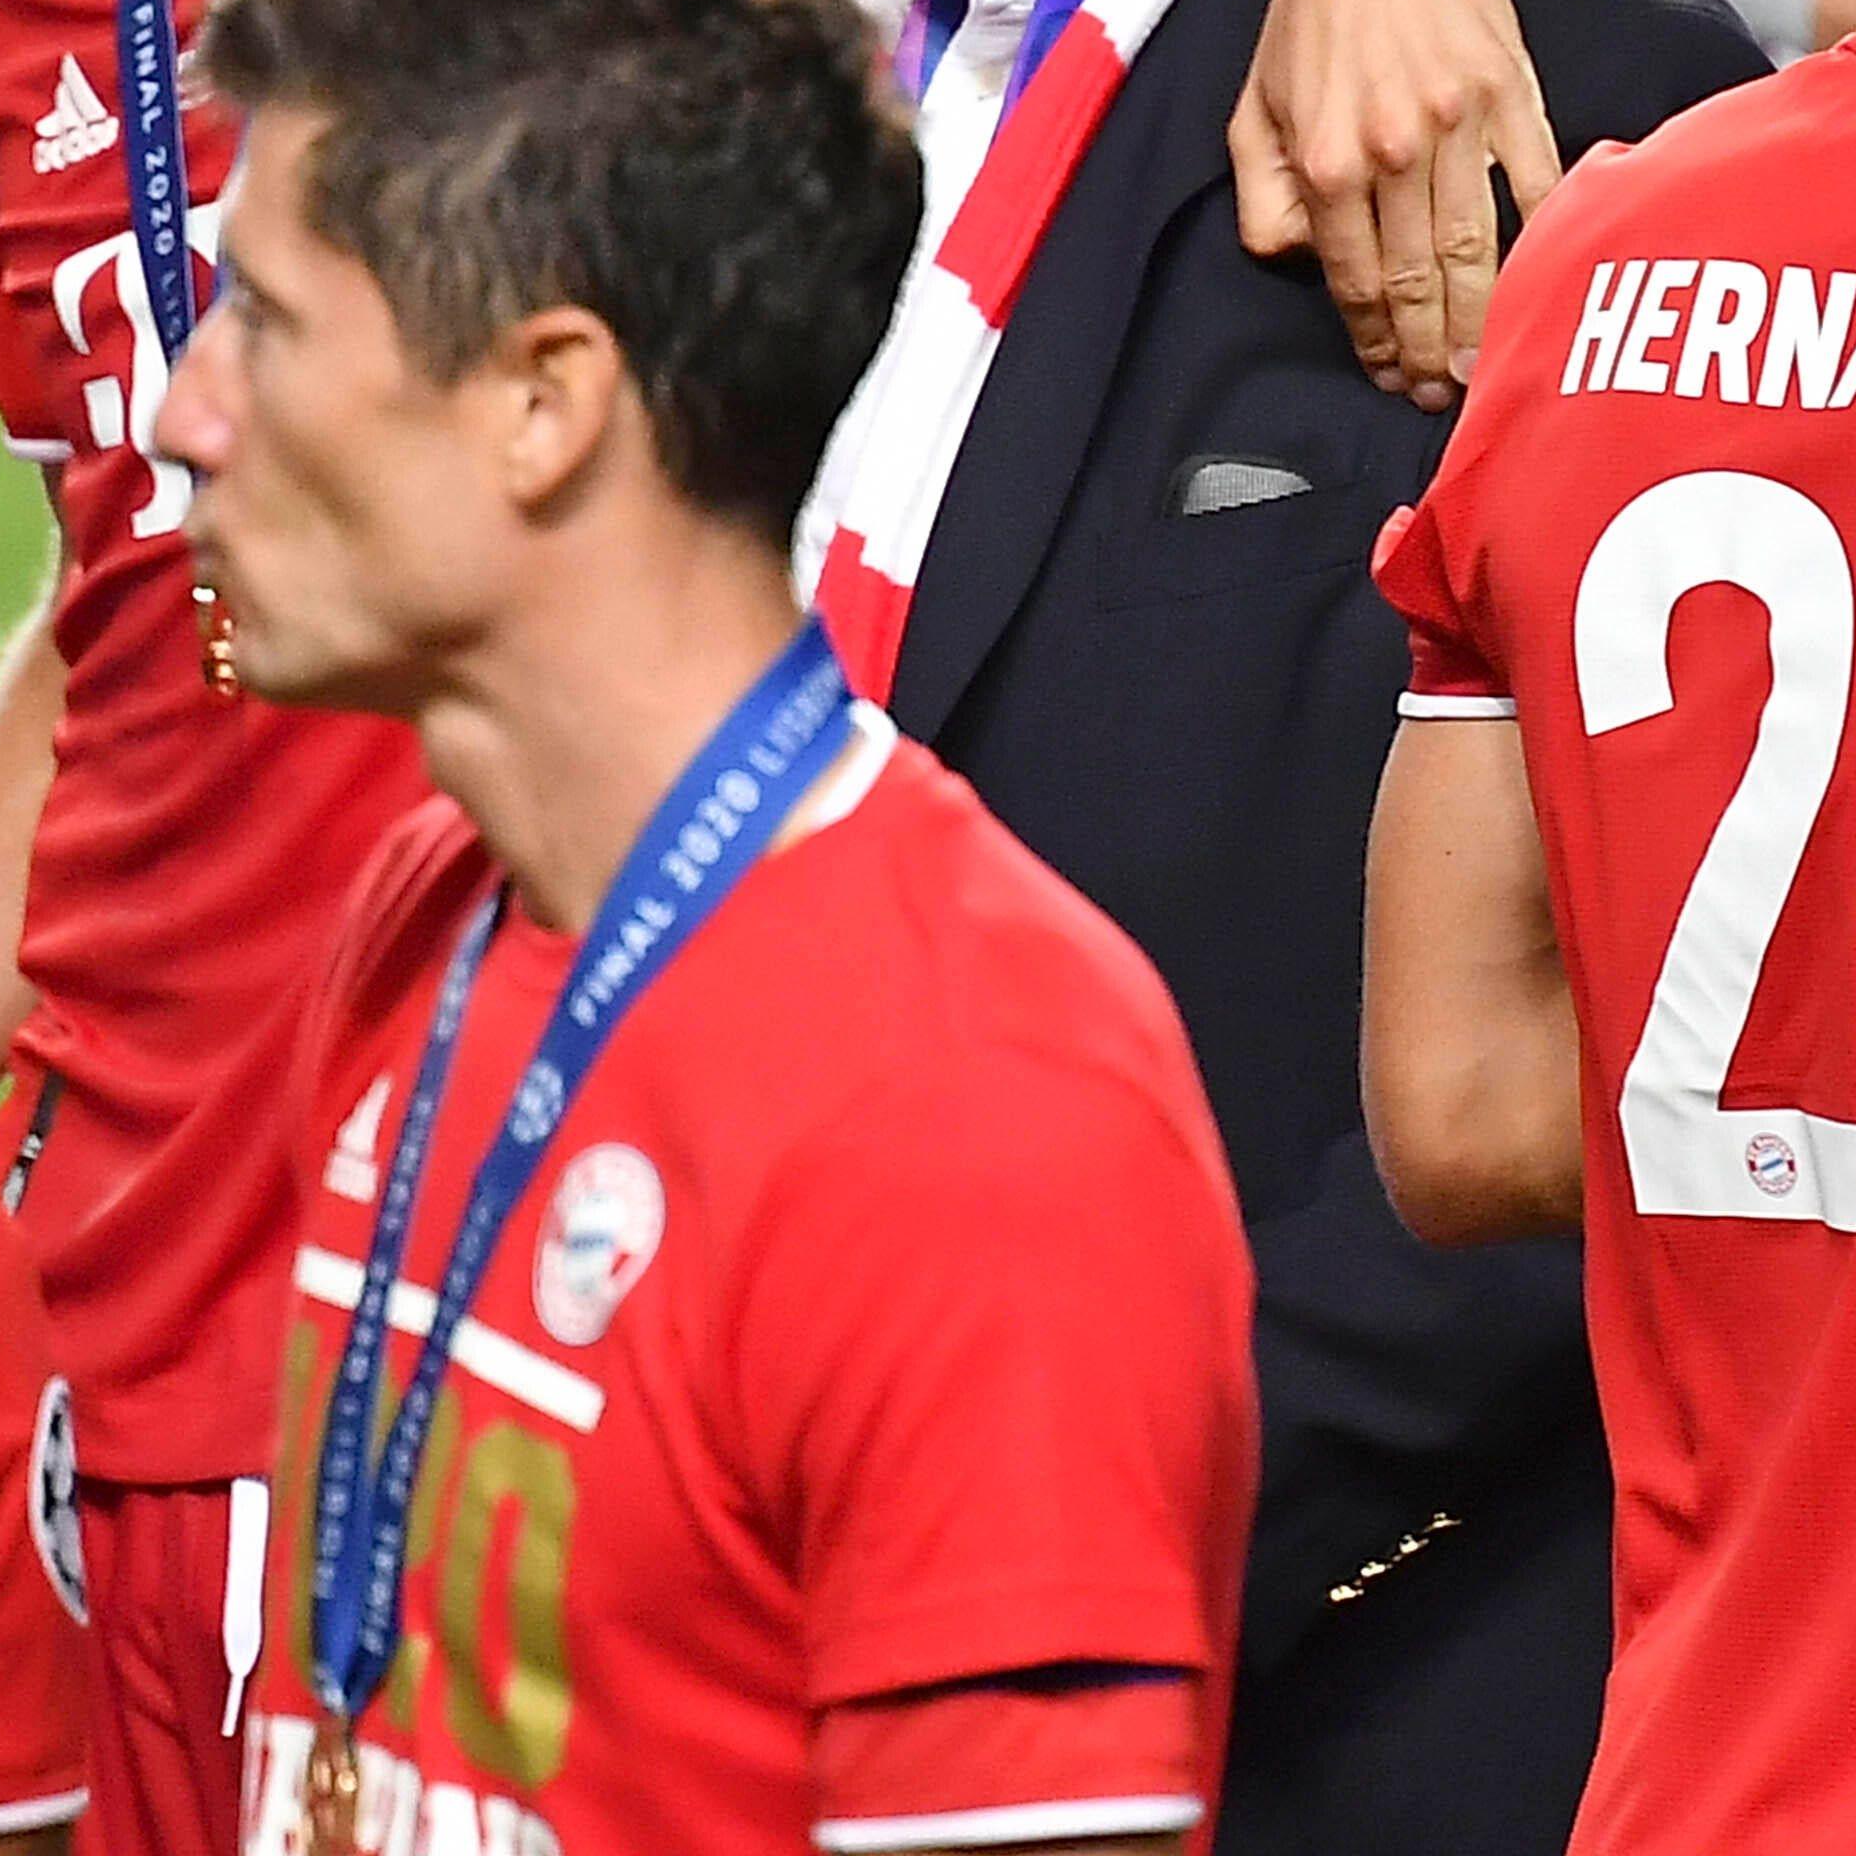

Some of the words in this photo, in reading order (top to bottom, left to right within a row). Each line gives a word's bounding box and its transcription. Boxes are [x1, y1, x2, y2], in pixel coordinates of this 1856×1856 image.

[130, 1, 164, 133] FINAL
[144, 145, 177, 257] 2020
[568, 894, 678, 1029] FINAL
[658, 767, 762, 892] 2020
